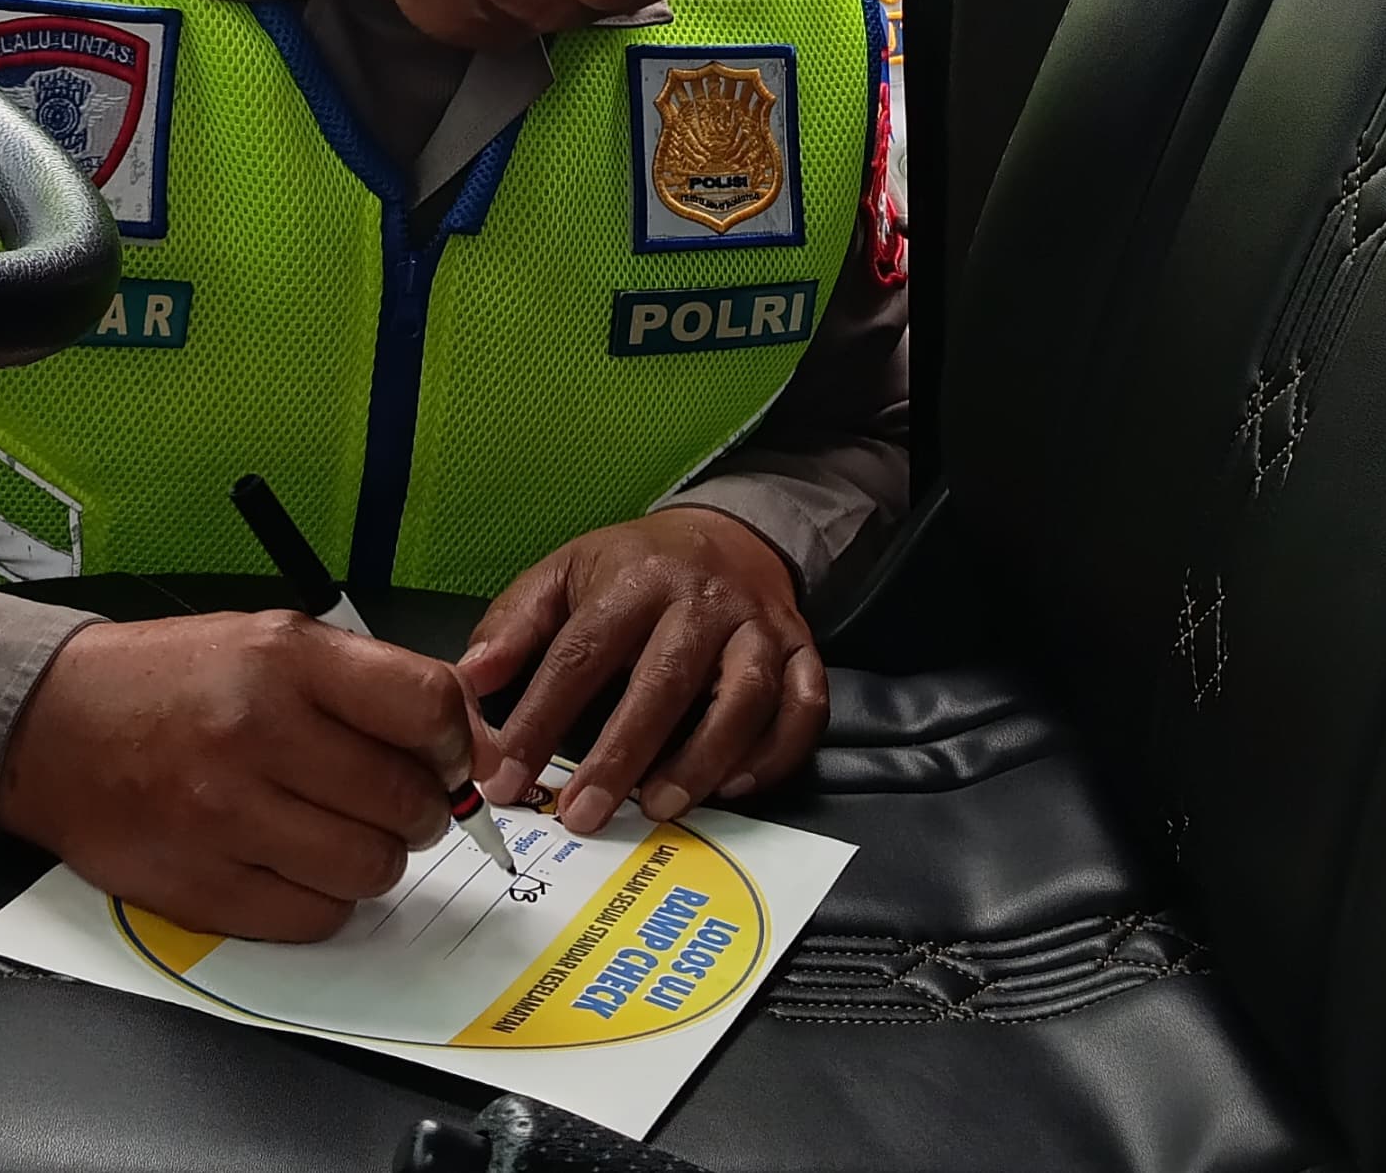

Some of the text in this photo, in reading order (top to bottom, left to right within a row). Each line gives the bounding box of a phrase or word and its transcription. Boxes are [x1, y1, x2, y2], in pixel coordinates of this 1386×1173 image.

[0, 30, 131, 63] LALU LINTAS
[689, 176, 749, 190] POLISI
[97, 293, 173, 337] AR
[628, 292, 805, 346] POLRI
[513, 829, 549, 856] Tanggal
[552, 840, 583, 863] Nomor
[491, 845, 680, 1034] LAIK JALAN SESUAI STANDAR KESELAMATAN
[571, 885, 710, 1021] RAMP CHECK
[644, 917, 740, 1012] LOLOS UJI
